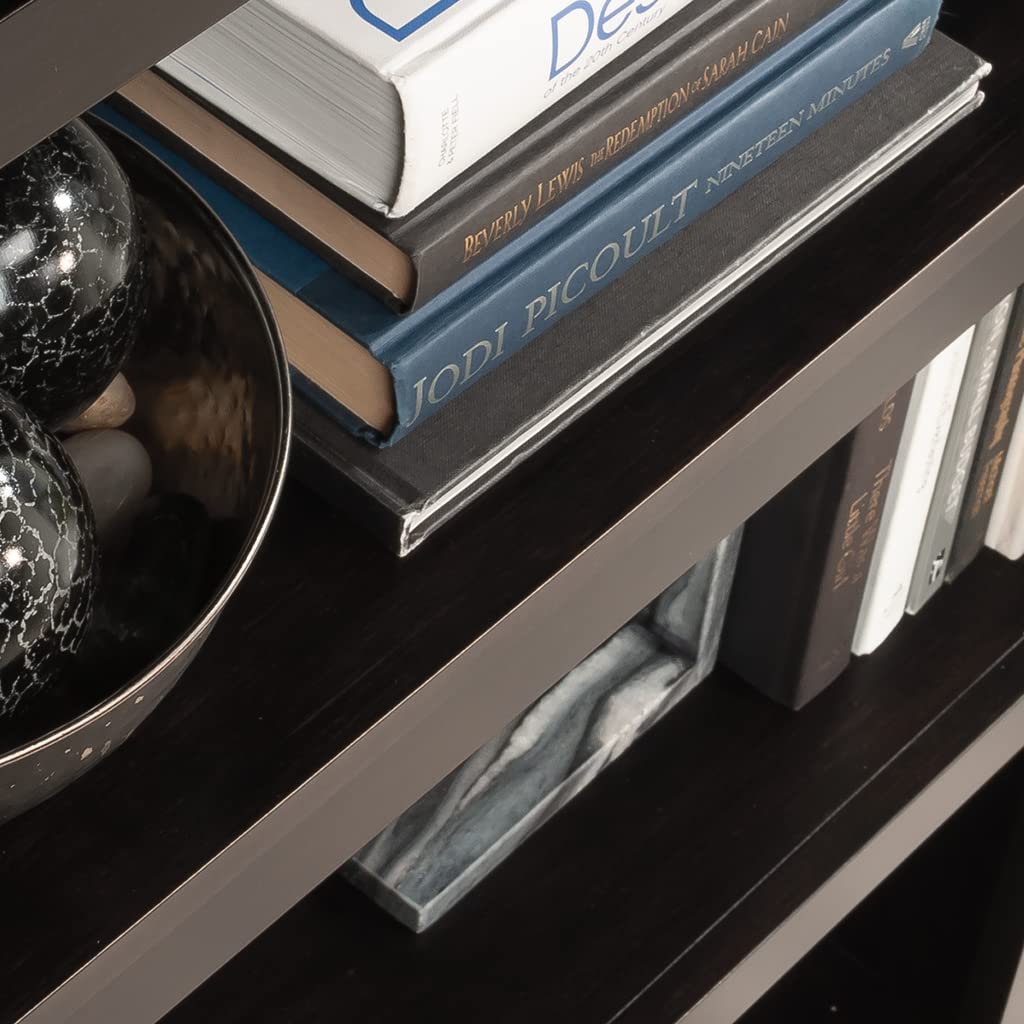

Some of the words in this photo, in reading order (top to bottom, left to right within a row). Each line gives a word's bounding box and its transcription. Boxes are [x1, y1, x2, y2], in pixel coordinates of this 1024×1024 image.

[406, 322, 508, 428] JODI
[522, 179, 699, 338] PICOULT
[704, 108, 805, 195] NINETEEN
[806, 47, 892, 121] MINUTES
[463, 194, 533, 264] BEVERLY
[536, 157, 585, 212] LEWIS
[604, 82, 691, 162] REDEMPTION
[701, 40, 750, 90] SARAH
[751, 12, 790, 55] CAIN
